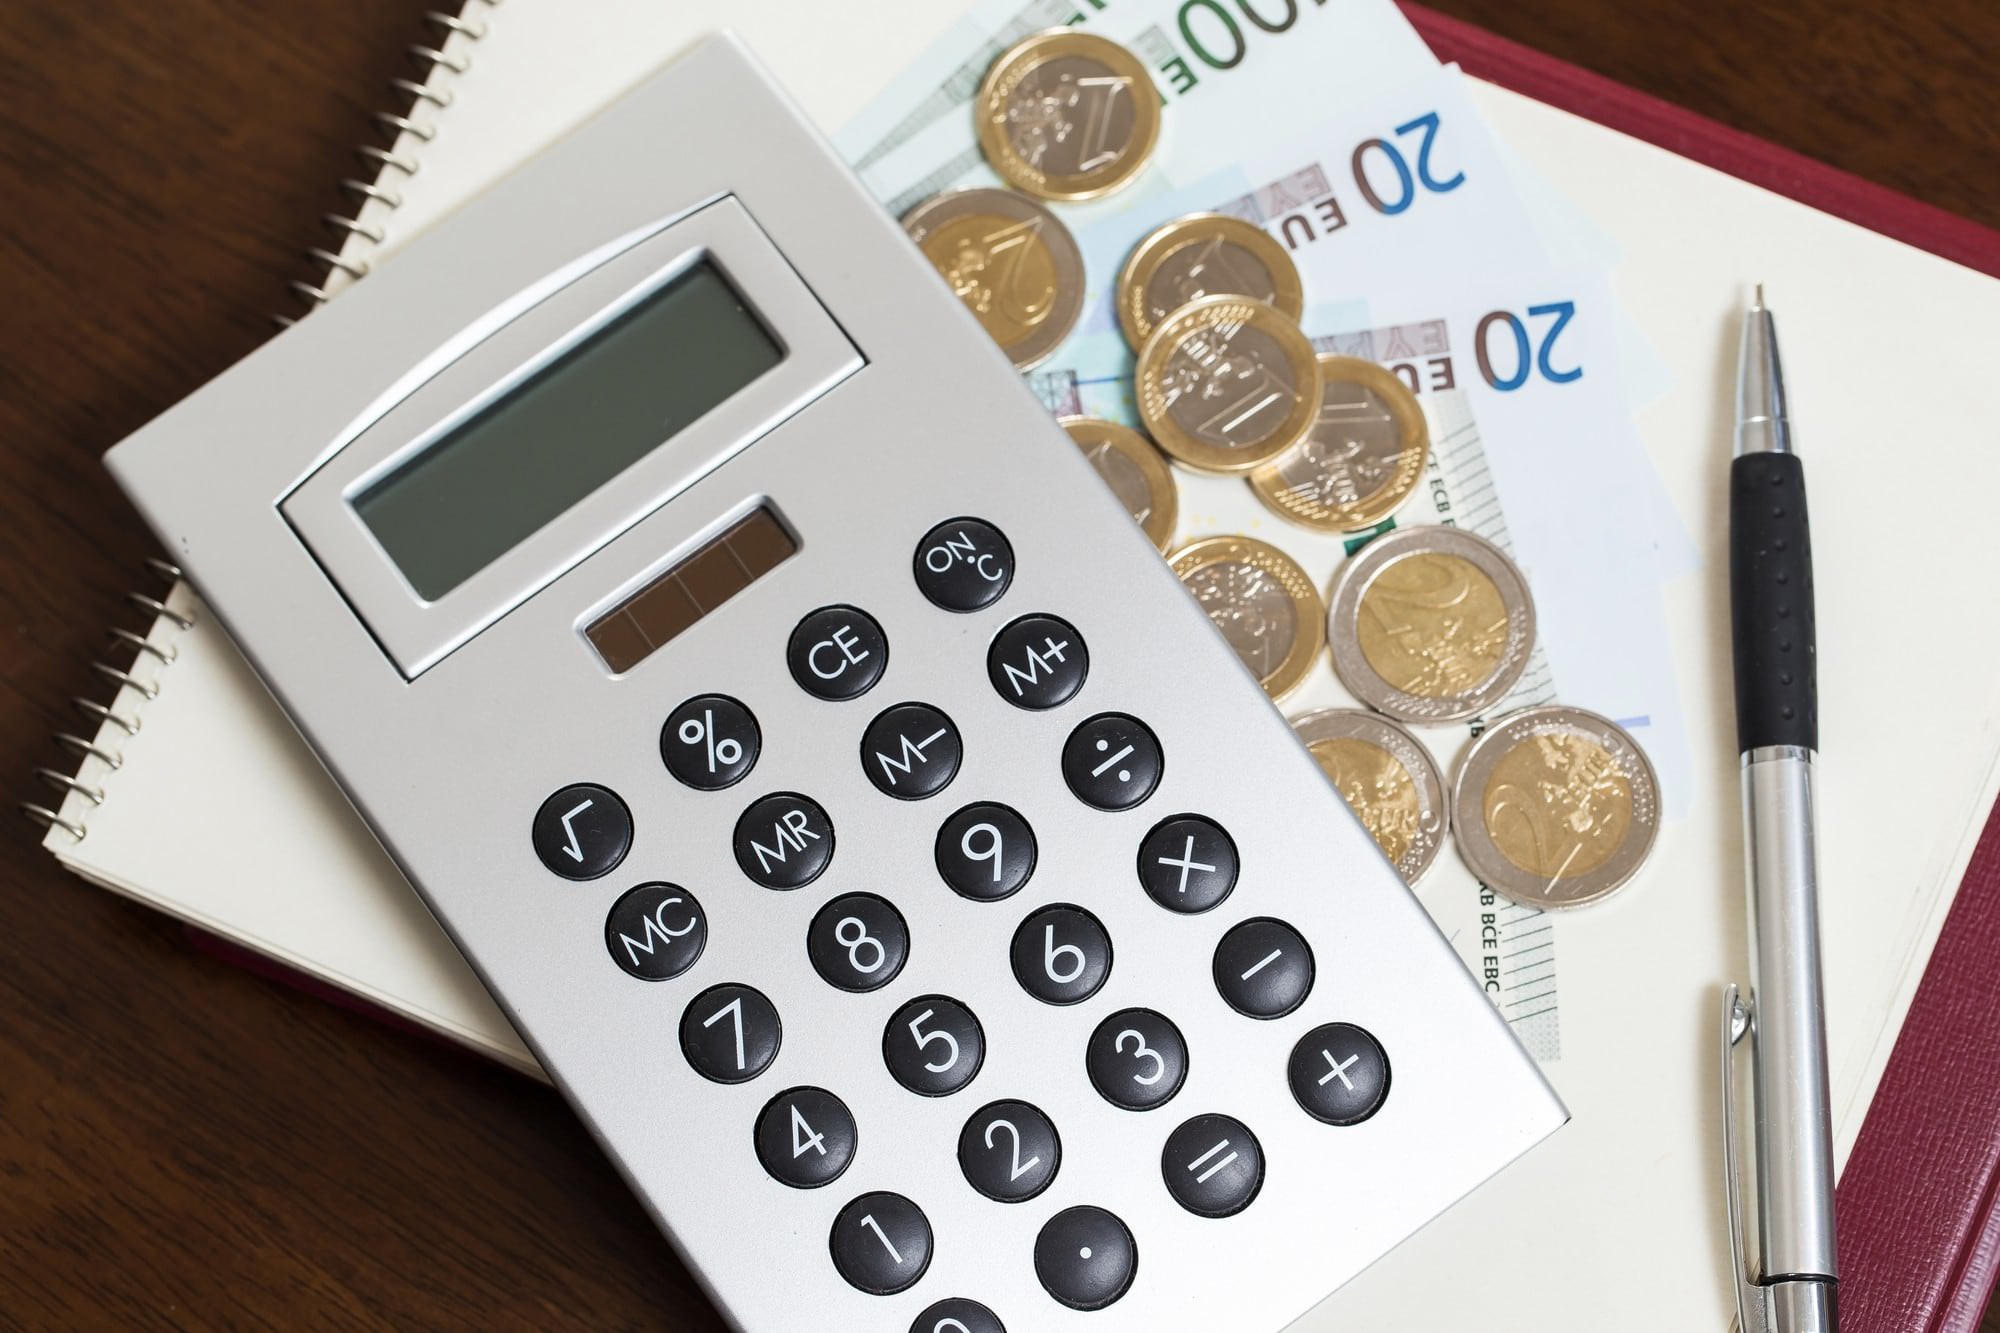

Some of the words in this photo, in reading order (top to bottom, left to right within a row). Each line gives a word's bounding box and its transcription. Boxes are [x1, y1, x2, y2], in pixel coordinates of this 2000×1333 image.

[1177, 0, 1326, 70] 00
[1351, 111, 1467, 216] 20
[1280, 197, 1348, 250] EU
[1389, 356, 1456, 394] EU
[1474, 301, 1583, 392] 20
[1429, 477, 1451, 513] ECB
[808, 625, 870, 679] CE
[1002, 637, 1068, 697] M+
[750, 809, 821, 874] MR
[961, 823, 1003, 882] 9
[619, 897, 697, 967] MC
[835, 916, 886, 974] 8
[1044, 924, 1086, 984] 6
[1483, 956, 1500, 993] EBC
[703, 997, 746, 1070] 7
[908, 1008, 960, 1073] 5
[1115, 1029, 1166, 1086] 3
[791, 1104, 827, 1159] 4
[984, 1119, 1041, 1182] 2
[860, 1213, 903, 1265] 1
